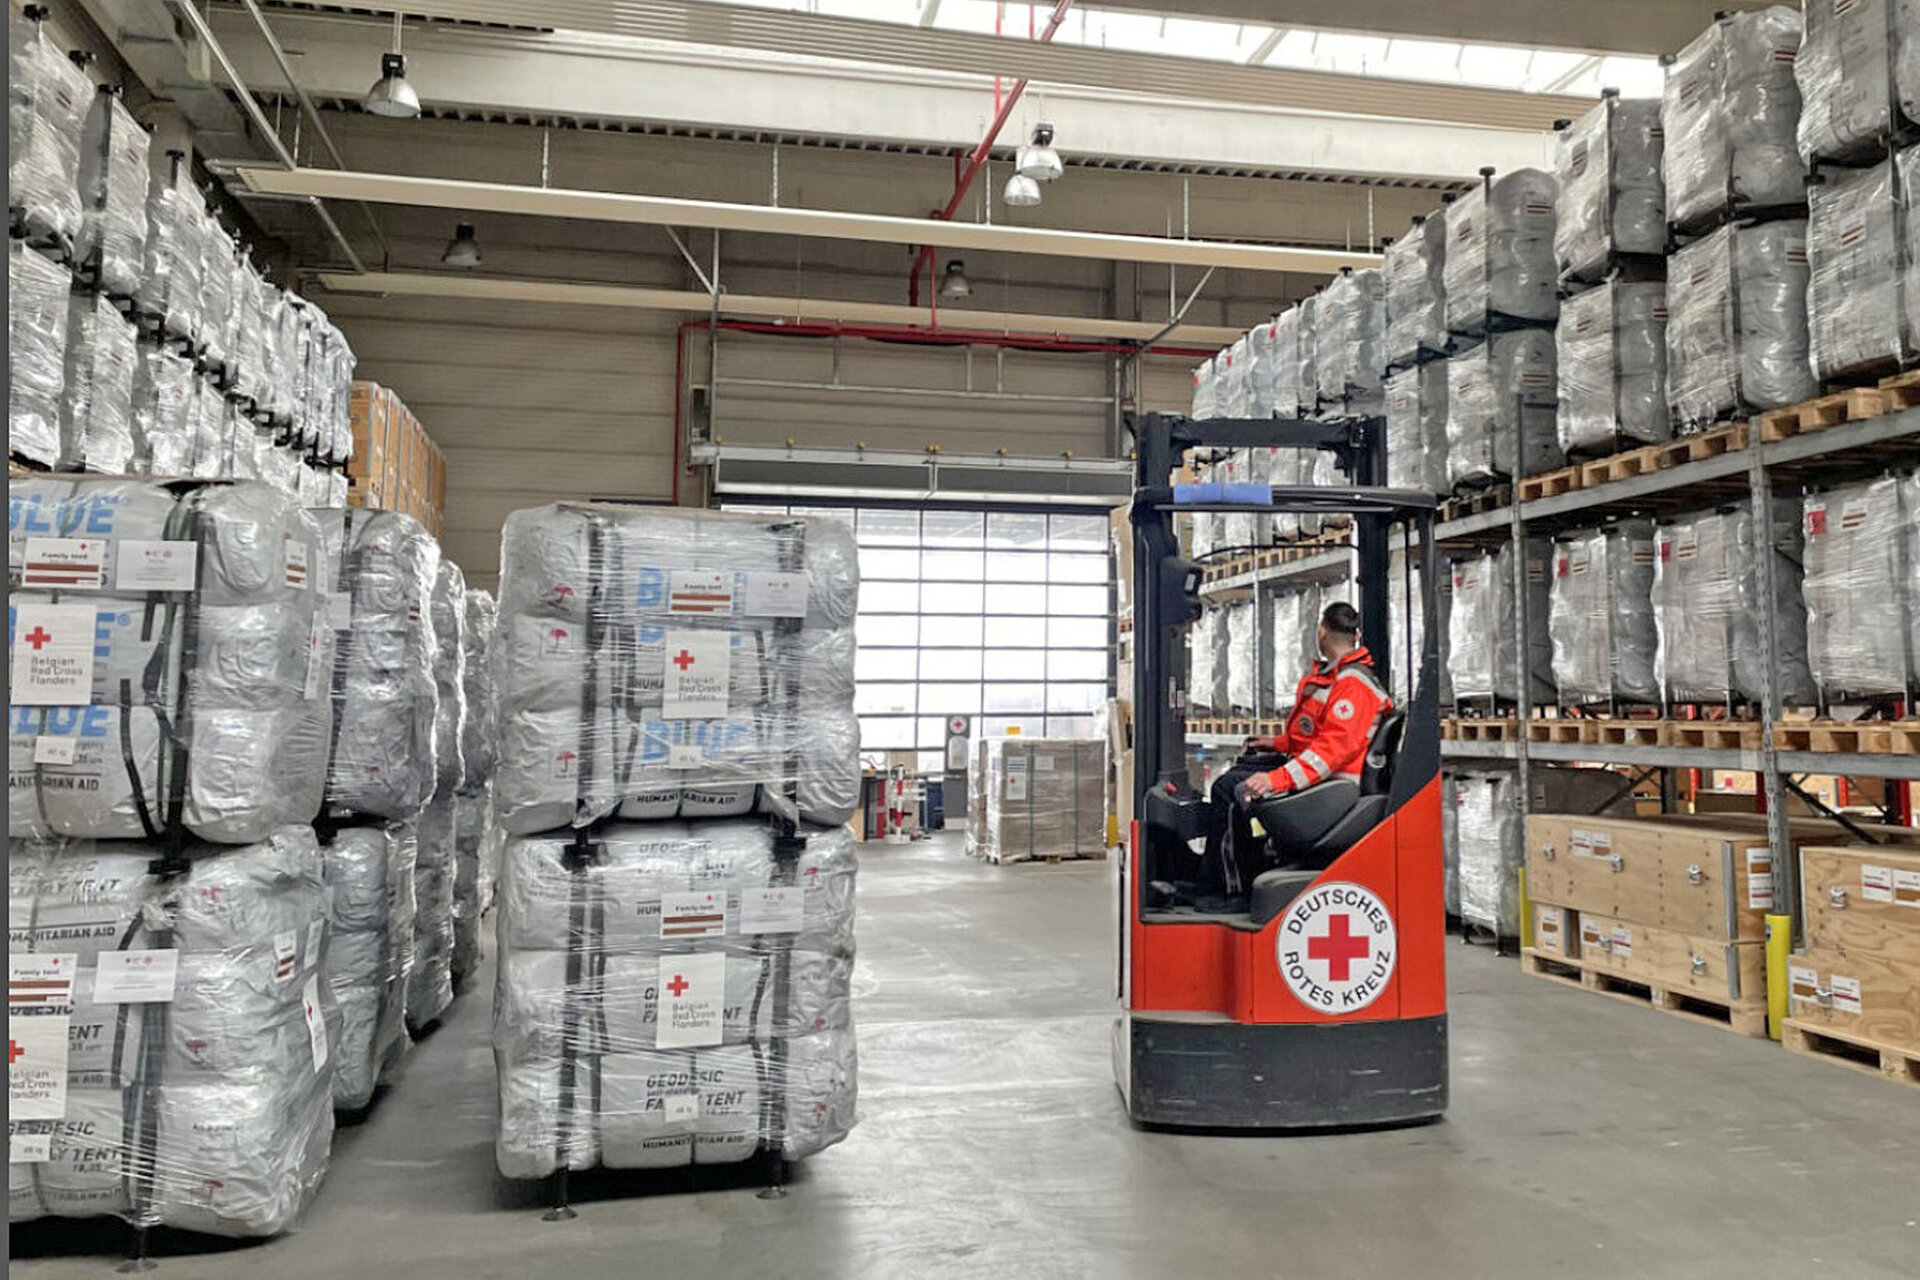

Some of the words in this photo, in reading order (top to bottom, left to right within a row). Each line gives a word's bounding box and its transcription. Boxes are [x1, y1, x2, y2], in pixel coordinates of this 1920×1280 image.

[31, 656, 75, 668] Belgian
[31, 666, 51, 676] Red
[54, 666, 83, 676] Cross
[30, 676, 76, 685] Flanders
[77, 777, 100, 791] AID
[1287, 889, 1387, 934] DEUTSCHES
[94, 926, 116, 937] AID
[1285, 951, 1334, 1006] ROTES
[1342, 950, 1391, 1006] KREUZ
[27, 1080, 57, 1089] Cross
[705, 1091, 746, 1106] TENT
